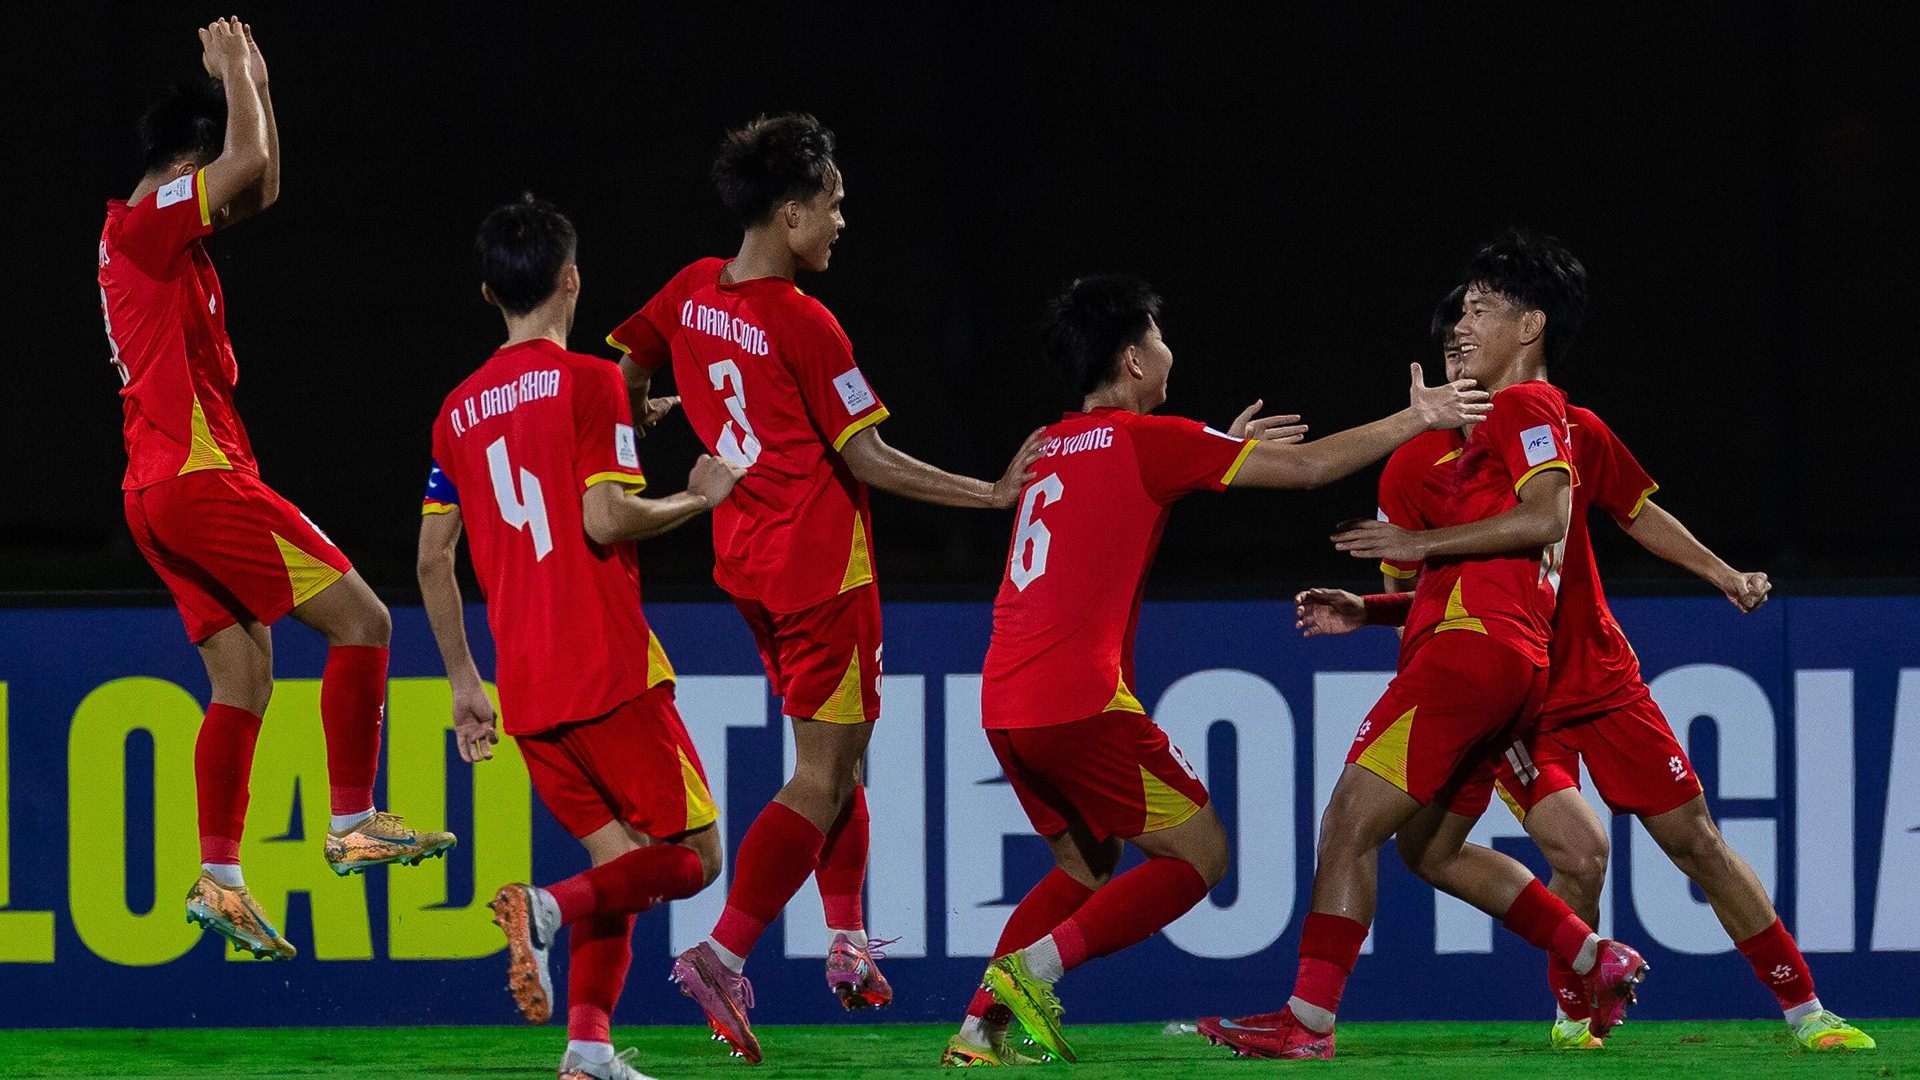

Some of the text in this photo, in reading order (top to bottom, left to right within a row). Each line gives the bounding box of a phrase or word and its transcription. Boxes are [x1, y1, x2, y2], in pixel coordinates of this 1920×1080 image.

[519, 369, 560, 404] KHOA
[708, 358, 762, 468] 3
[1528, 435, 1549, 450] AFC
[486, 435, 553, 563] 4
[1010, 472, 1064, 592] 6
[669, 673, 1040, 958] THE
